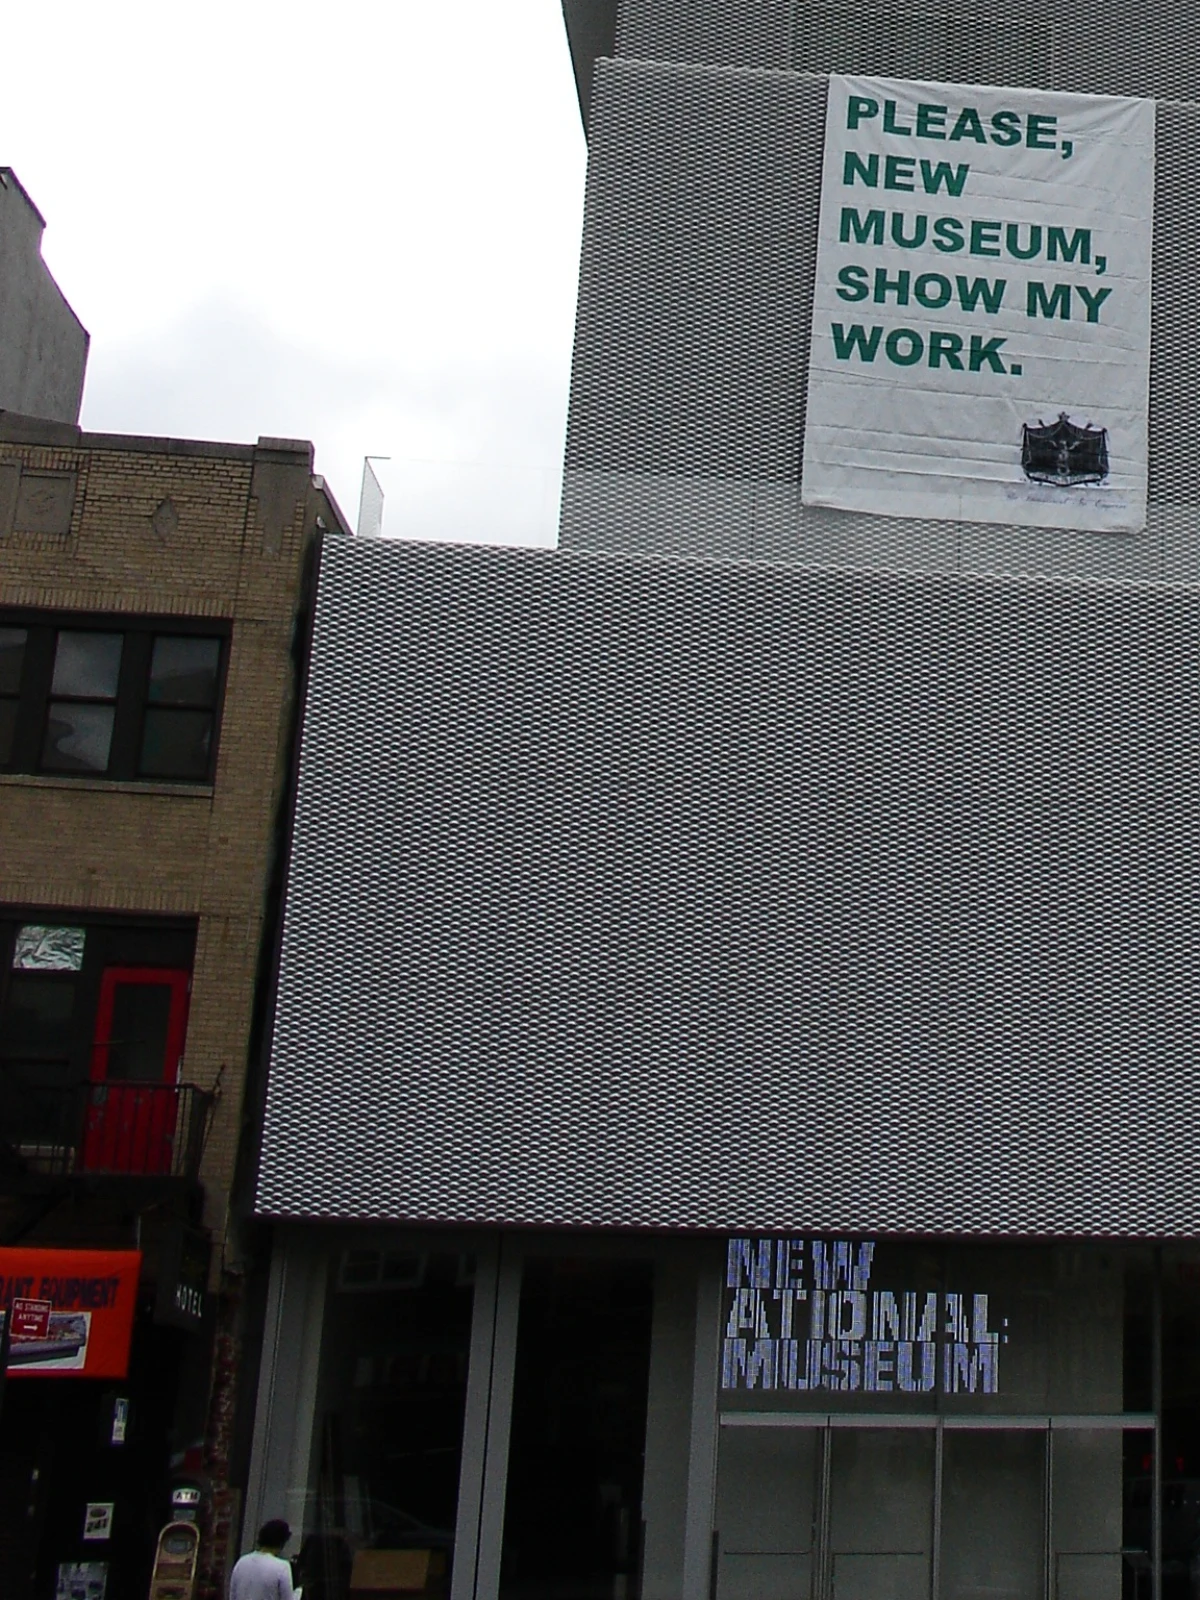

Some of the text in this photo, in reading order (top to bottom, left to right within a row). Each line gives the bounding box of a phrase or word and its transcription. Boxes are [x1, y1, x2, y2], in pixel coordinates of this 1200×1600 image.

[846, 95, 1073, 160] PLEASE,
[842, 151, 970, 197] NEW
[838, 207, 1108, 276] MUSEUM,
[835, 265, 1113, 323] SHOW MY
[831, 322, 1023, 376] WORK.
[727, 1238, 876, 1291] NEW
[174, 1283, 202, 1319] HOTEL
[721, 1338, 999, 1393] MUSEUM
[176, 1491, 198, 1500] ATM
